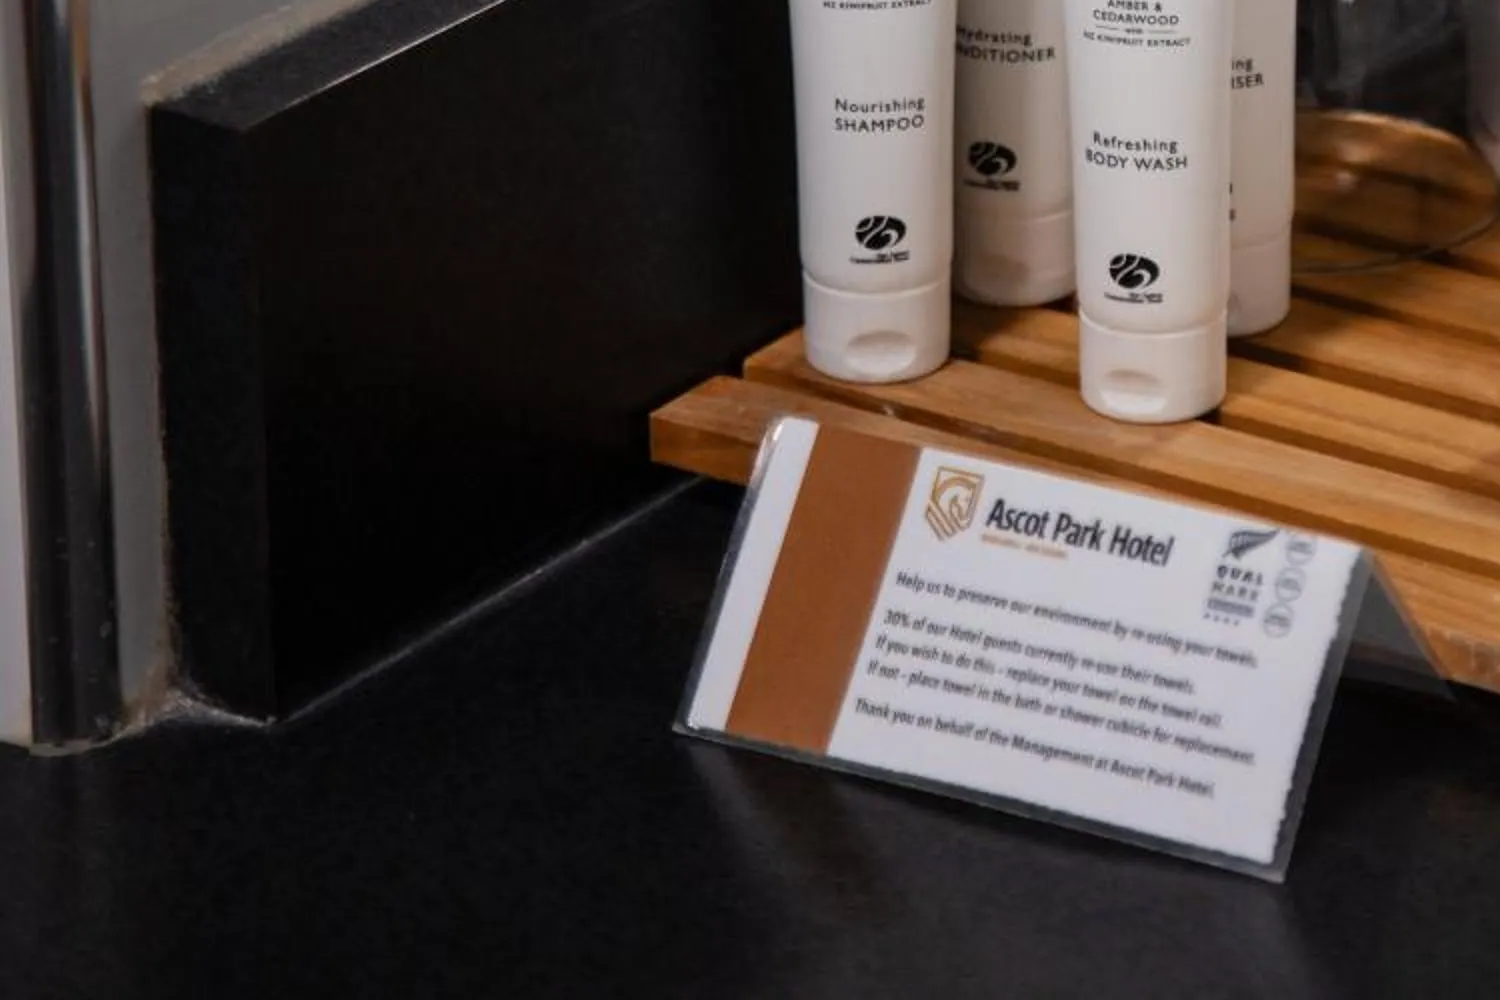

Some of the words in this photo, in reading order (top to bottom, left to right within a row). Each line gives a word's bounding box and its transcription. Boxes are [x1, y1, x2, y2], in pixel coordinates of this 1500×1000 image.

[1093, 9, 1179, 25] CEDARWOOD
[835, 96, 925, 112] Nourishing
[835, 114, 925, 133] SHAMPOO
[1093, 130, 1178, 154] Refreshing
[1085, 148, 1129, 169] BODY
[1133, 156, 1188, 172] WASH
[985, 497, 1049, 540] Ascot
[1052, 511, 1104, 552] Park
[1108, 524, 1175, 568] Hotel
[896, 571, 924, 593] Help
[926, 582, 941, 595] us
[943, 583, 956, 599] to
[956, 588, 1009, 609] preserve
[1010, 600, 1032, 614] our
[1033, 604, 1112, 632] environment
[1113, 619, 1128, 641] by
[912, 616, 927, 631] of
[927, 622, 948, 636] our
[949, 622, 983, 645] Hotel
[876, 633, 888, 650] If
[887, 639, 910, 656] you
[911, 645, 939, 661] wish
[941, 651, 953, 666] to
[955, 652, 972, 669] do
[973, 657, 995, 675] this
[1006, 667, 1051, 688] replace
[867, 658, 880, 676] If
[879, 664, 900, 680] not
[908, 670, 940, 689] place
[991, 688, 1012, 705] the
[855, 697, 891, 720] Thank
[891, 709, 916, 726] you
[916, 715, 933, 730] on
[934, 716, 975, 739] behalf
[974, 727, 989, 742] of
[989, 730, 1009, 747] the
[1011, 734, 1094, 769] Management
[1109, 758, 1146, 782] Ascot
[1147, 767, 1174, 788] Park
